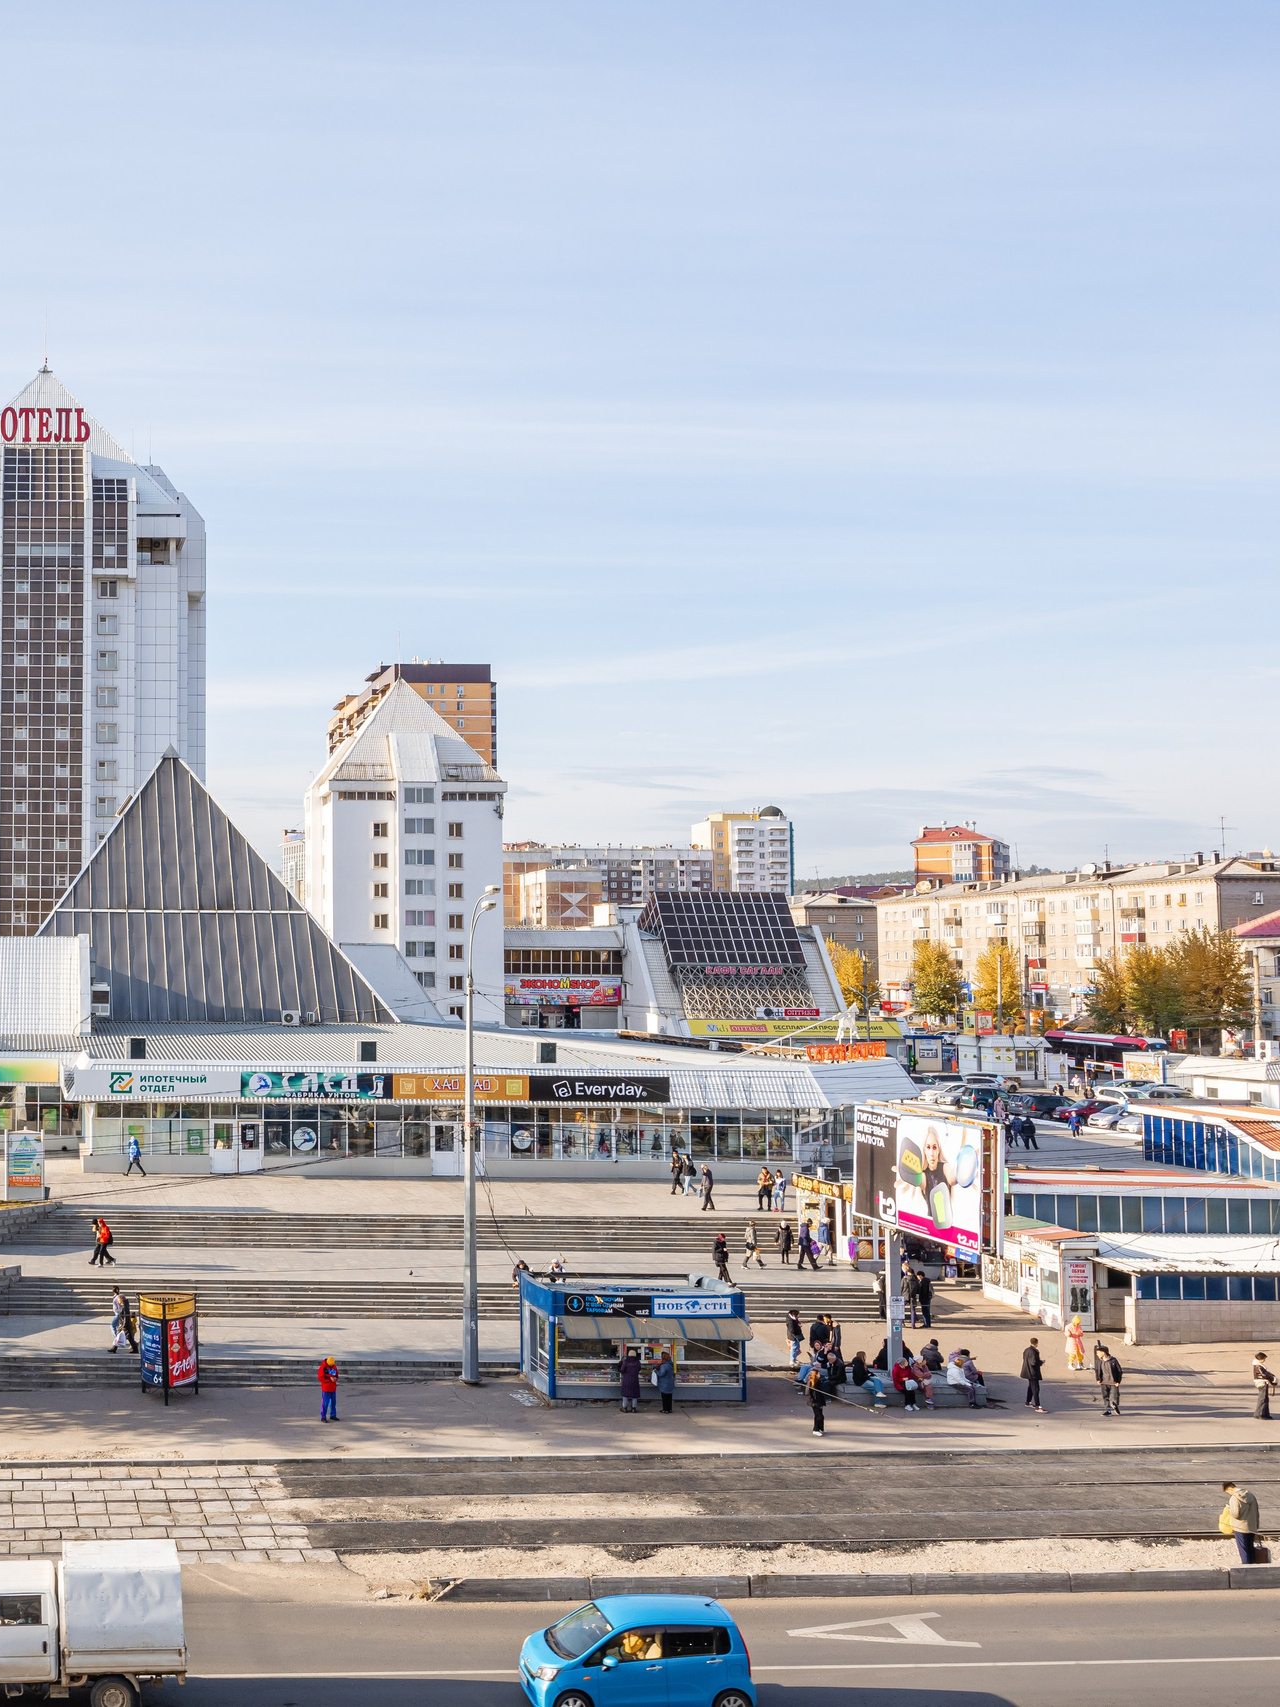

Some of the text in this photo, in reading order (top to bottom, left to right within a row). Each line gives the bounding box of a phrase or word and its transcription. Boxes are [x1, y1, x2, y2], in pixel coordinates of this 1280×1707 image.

[1, 407, 90, 442] ОТЕЛЬ
[139, 1075, 207, 1084] ИПОТЕЧНЫЙ
[139, 1085, 175, 1093] ОТДЕЛ
[575, 1082, 643, 1098] Everyday
[857, 1112, 897, 1128] ГИГАБАЙТЫ
[857, 1123, 889, 1137] ВПЕРВЫЕ
[857, 1133, 885, 1147] ВАЛЮТА
[957, 1233, 978, 1249] t2.ru
[171, 1321, 180, 1330] 21
[153, 1374, 163, 1384] 6+
